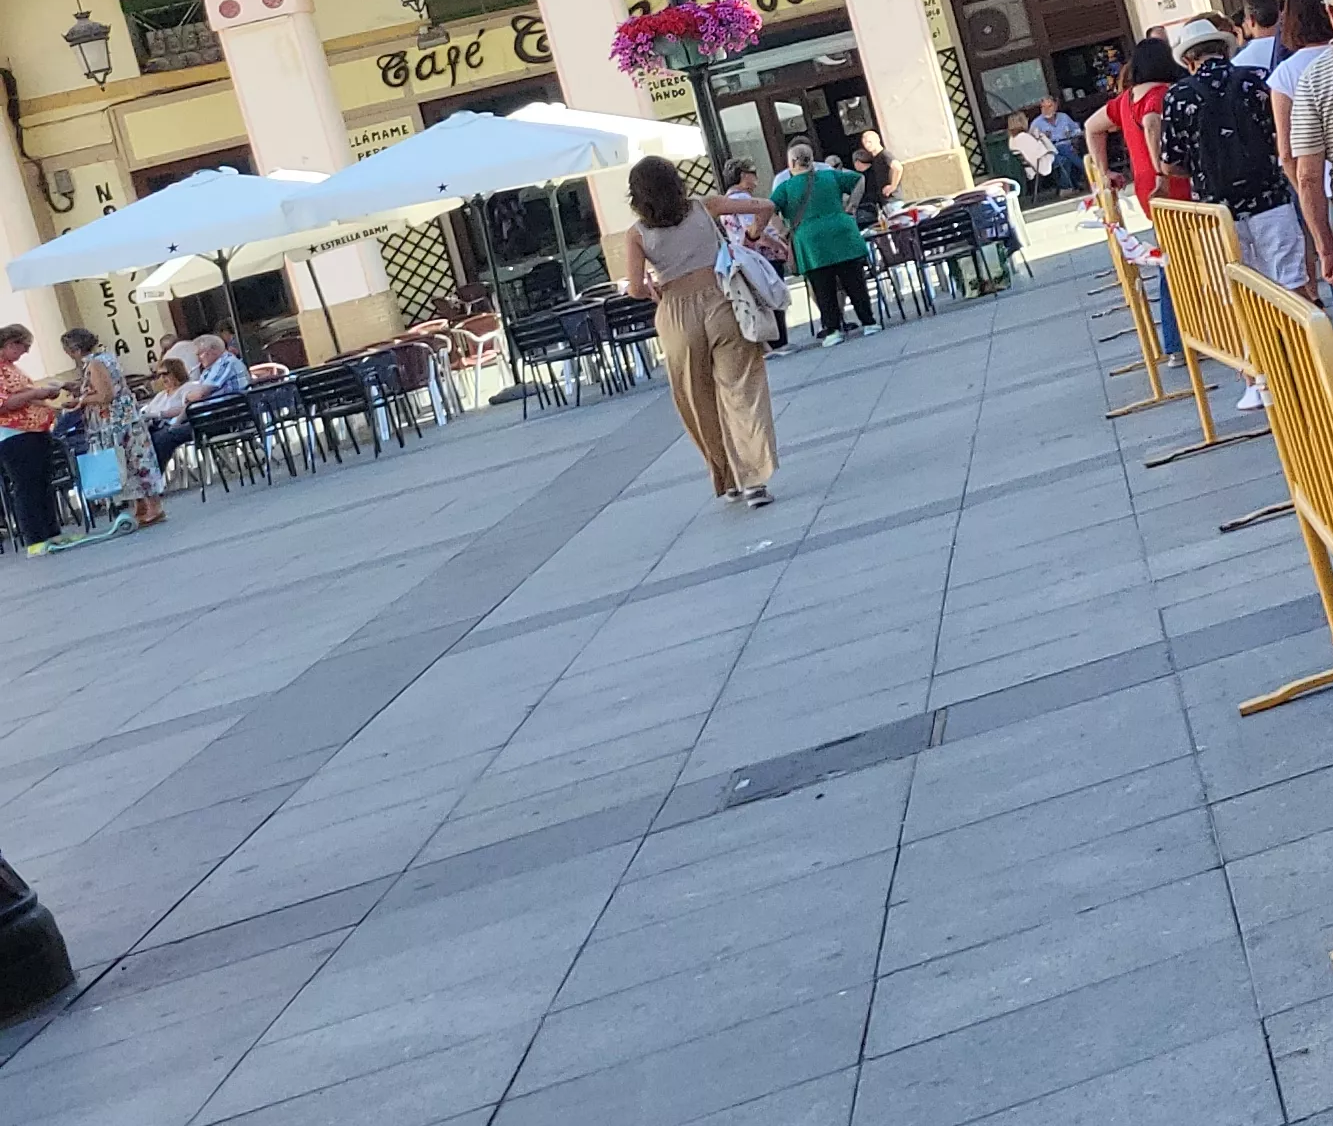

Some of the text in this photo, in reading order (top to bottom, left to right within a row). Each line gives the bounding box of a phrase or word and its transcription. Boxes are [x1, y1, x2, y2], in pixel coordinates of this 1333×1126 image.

[376, 28, 485, 87] Café
[320, 225, 389, 251] ESTRELLA DAMM
